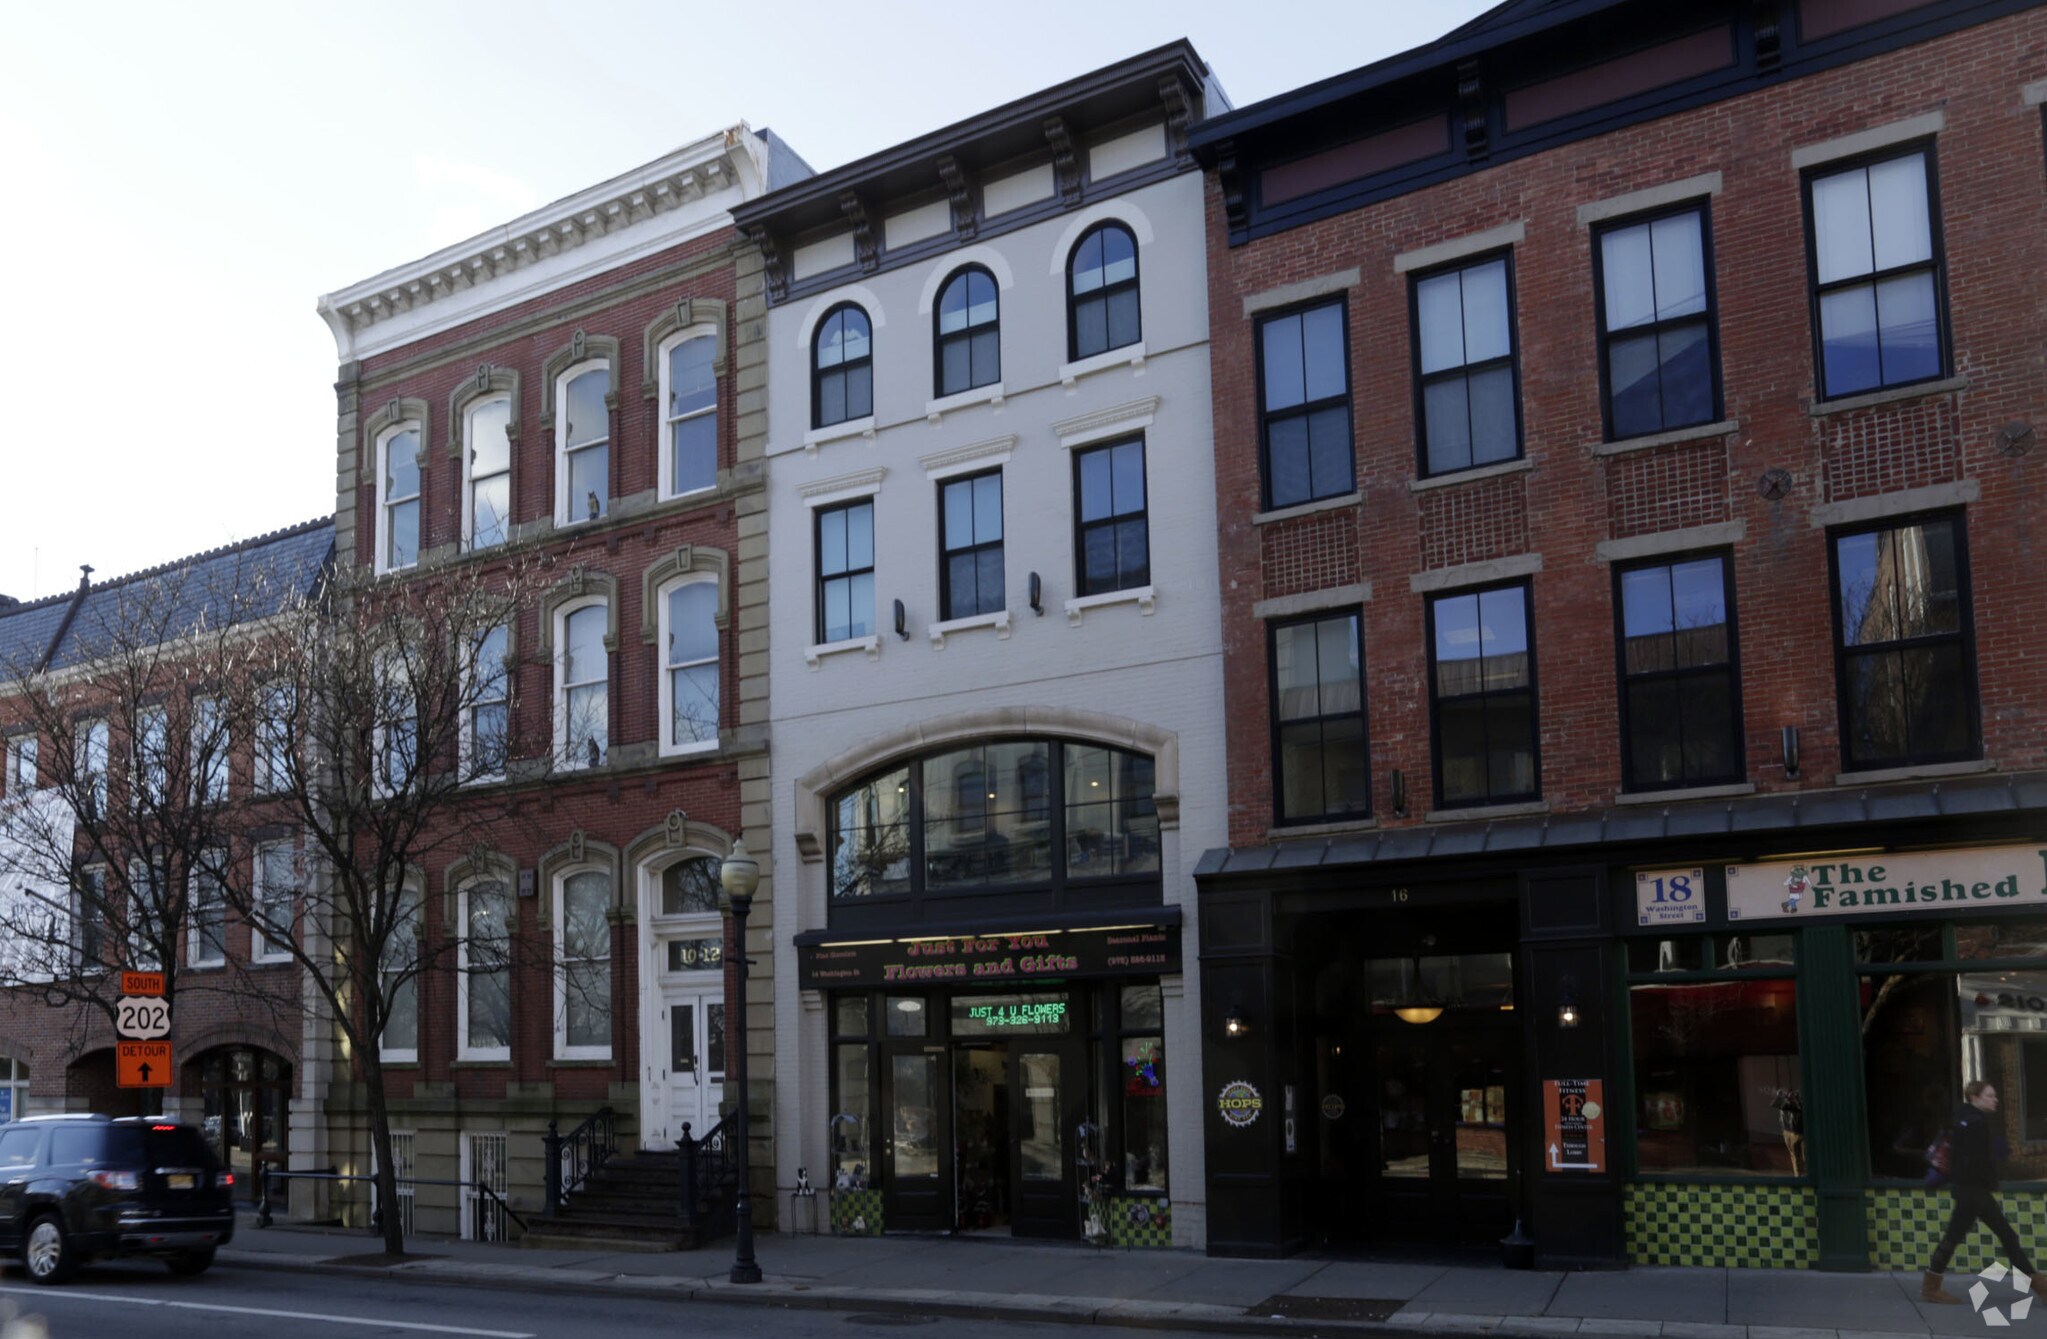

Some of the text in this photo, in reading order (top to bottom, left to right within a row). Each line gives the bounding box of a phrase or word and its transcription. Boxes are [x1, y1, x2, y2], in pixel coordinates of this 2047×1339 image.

[1812, 863, 1887, 886] The
[1391, 888, 1408, 902] 16
[1649, 875, 1693, 903] 18
[1812, 874, 2019, 909] Famished
[1645, 902, 1698, 914] Washington
[1658, 911, 1685, 920] Street
[907, 934, 1049, 957] Just For You
[883, 955, 1079, 981] Flowers and Gifts
[126, 977, 160, 990] SOUTH
[122, 1006, 165, 1030] 202
[969, 1003, 1066, 1018] JUST 4 U FLOWERS
[122, 1045, 167, 1058] DETOUR
[1219, 1098, 1262, 1109] HOPS
